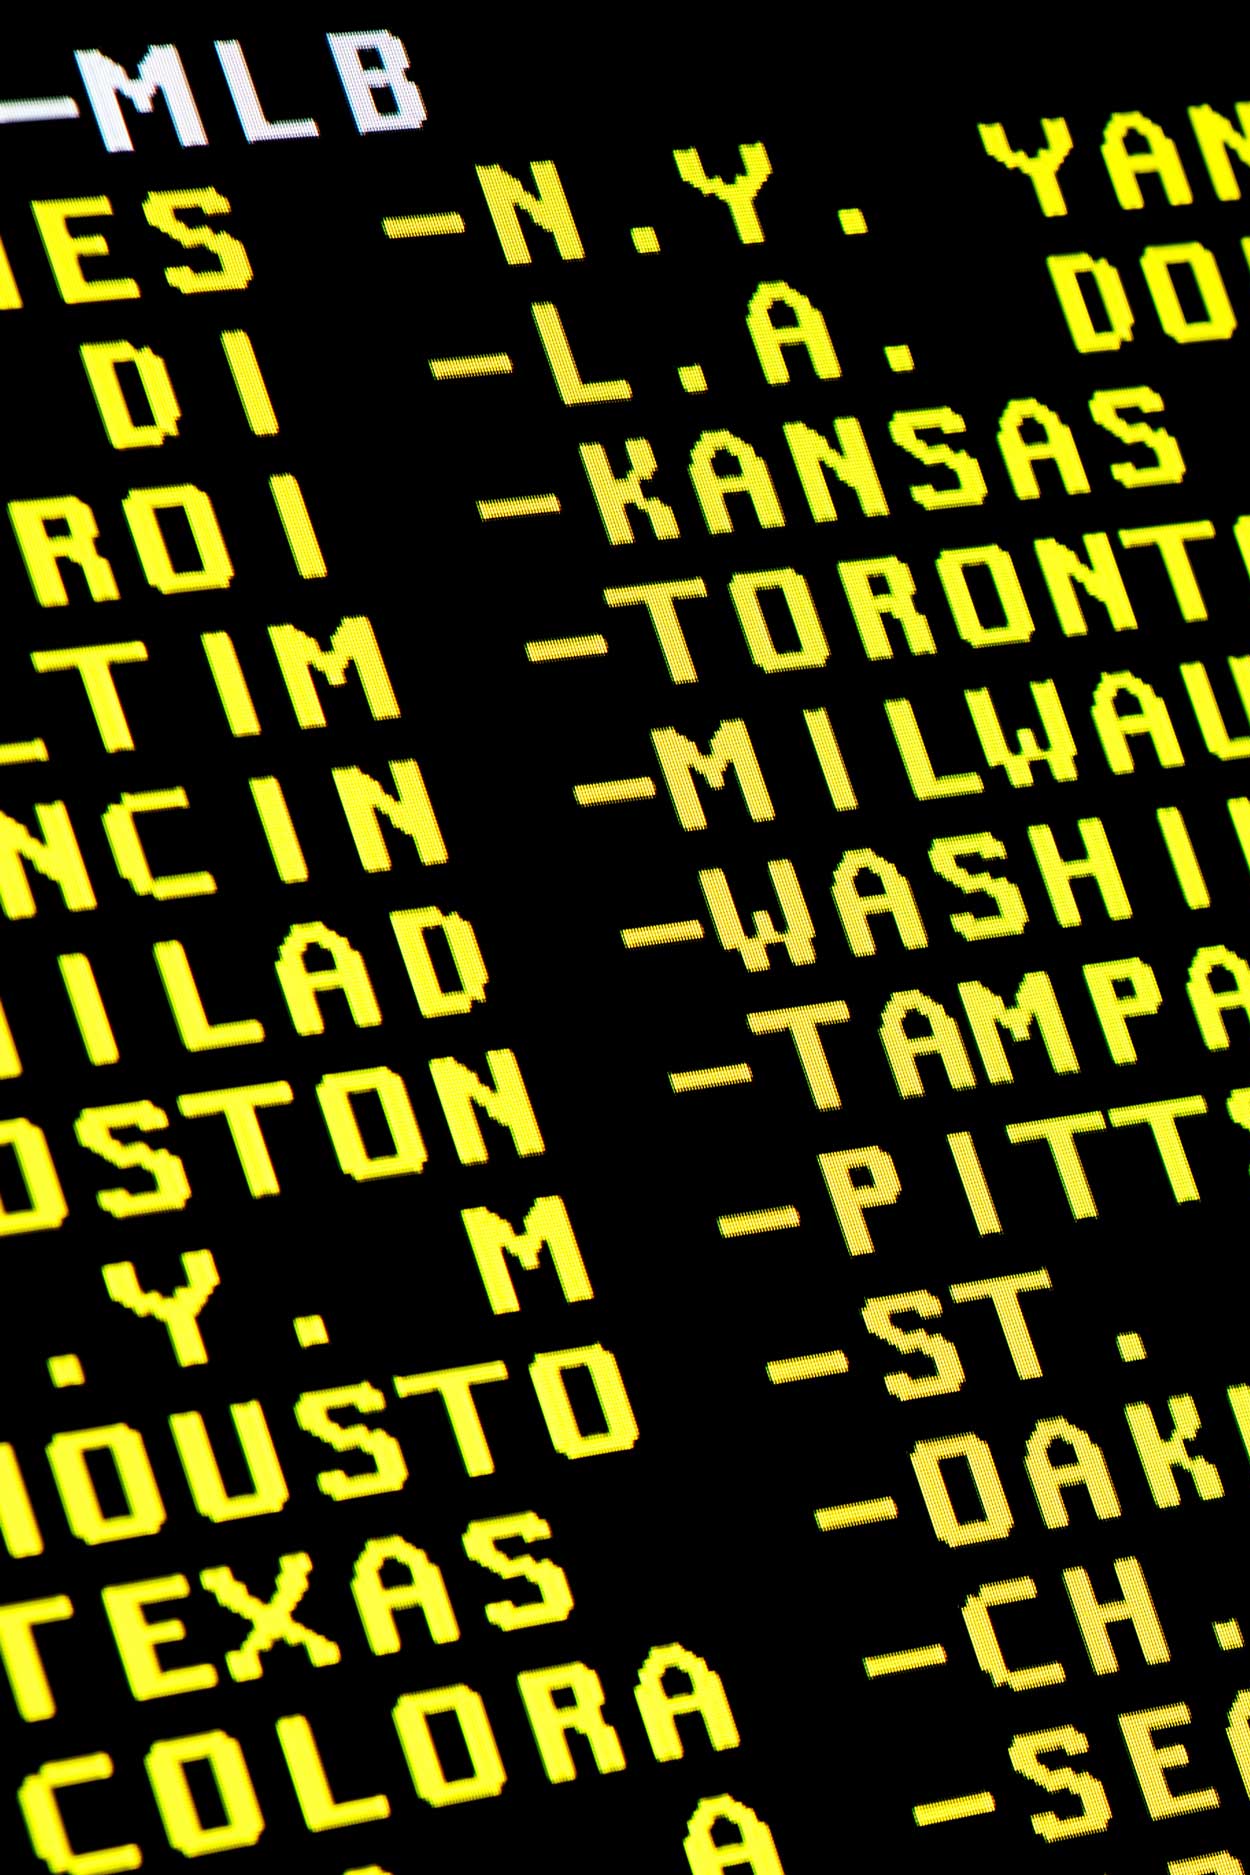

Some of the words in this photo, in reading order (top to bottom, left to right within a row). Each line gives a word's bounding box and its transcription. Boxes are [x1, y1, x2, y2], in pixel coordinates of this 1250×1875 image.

[0, 29, 427, 152] -MLB
[0, 186, 253, 310] ES
[382, 142, 868, 265] -N.Y.
[80, 329, 279, 449] DI
[429, 281, 914, 407] -L.A.
[8, 473, 327, 607] ROI
[476, 386, 1186, 545] -KANSAS
[0, 758, 448, 920] NCIN
[0, 906, 489, 1079] ILAD
[461, 1195, 594, 1314] M
[766, 1267, 1146, 1401] -ST.
[0, 1511, 574, 1722] TEXAS
[18, 1642, 740, 1875] COLORA
[863, 1556, 1244, 1691] -CH.
